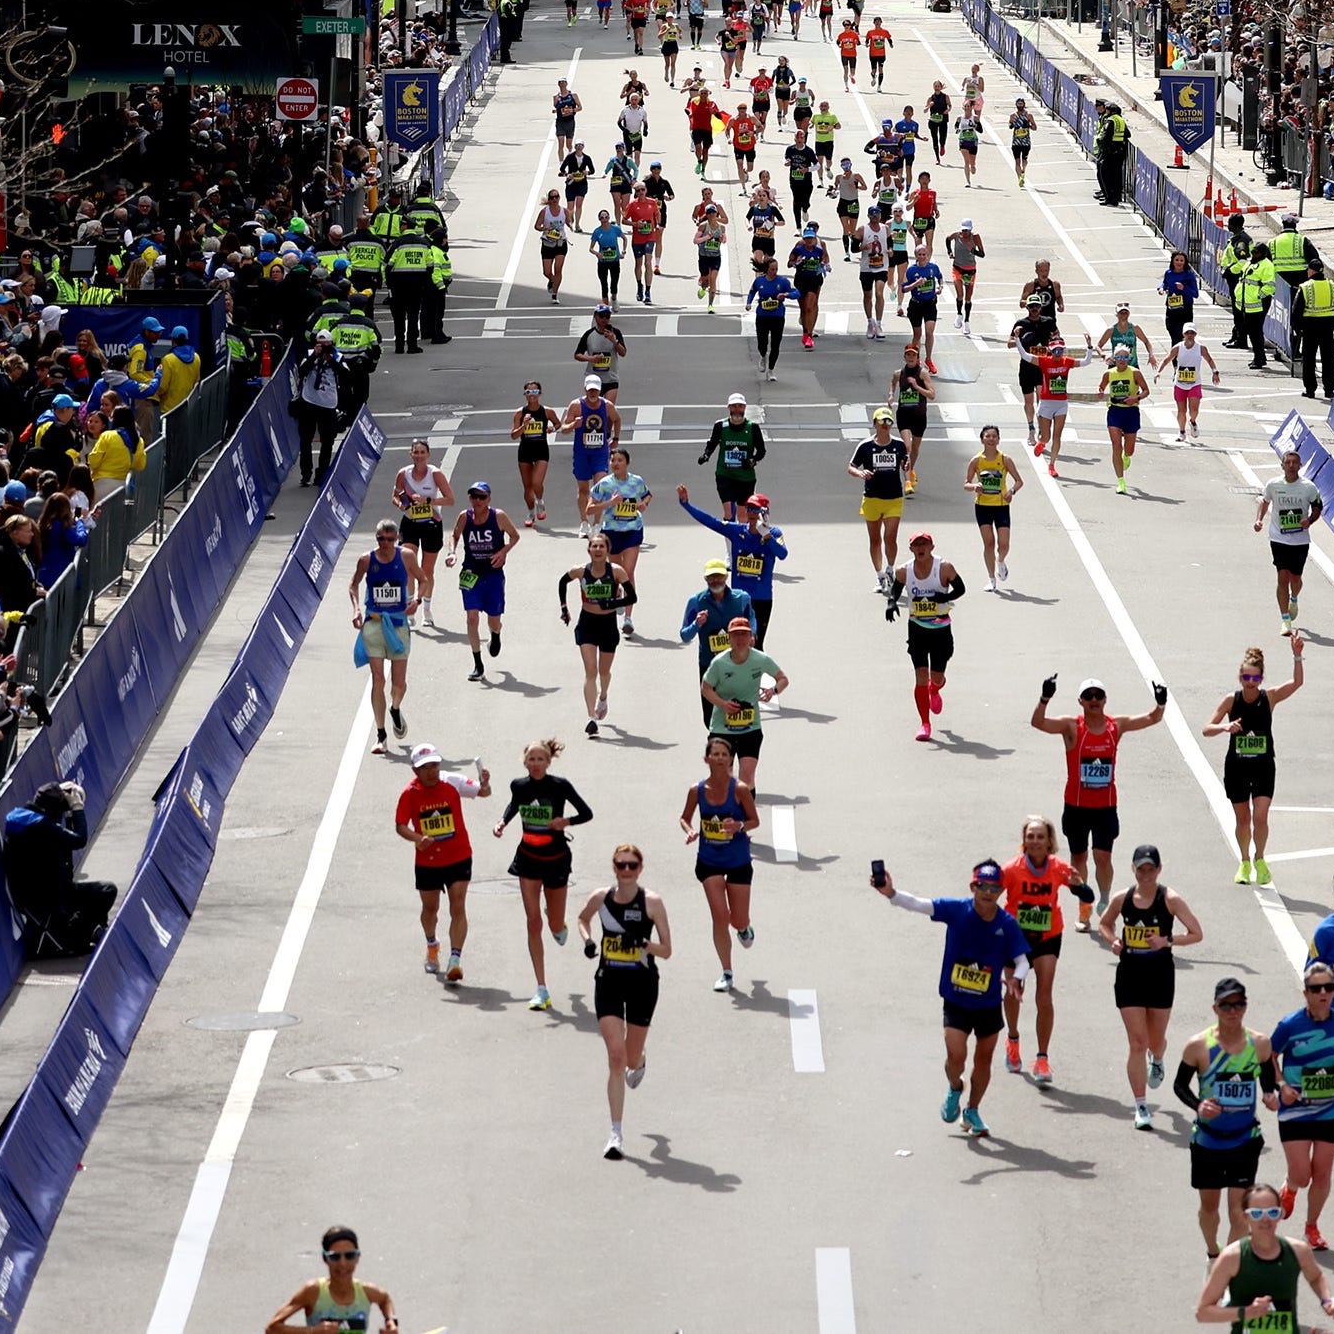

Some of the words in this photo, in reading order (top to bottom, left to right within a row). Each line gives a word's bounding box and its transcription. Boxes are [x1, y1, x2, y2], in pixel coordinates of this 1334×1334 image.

[316, 21, 349, 33] EXETER
[163, 50, 210, 63] HOTEL
[283, 86, 293, 94] DO
[297, 86, 312, 94] NOT
[285, 104, 309, 112] ENTER
[397, 107, 427, 115] BOSTON
[1174, 109, 1203, 117] BOSTON
[355, 253, 375, 261] POLICE
[406, 257, 422, 265] POLICE
[339, 330, 362, 339] Boston
[339, 337, 361, 346] Police
[875, 455, 895, 463] 10055
[1278, 497, 1303, 505] ITALIA
[468, 529, 493, 543] ALS
[375, 588, 398, 598] 11501
[420, 801, 449, 812] CHINA
[423, 817, 451, 831] 19811
[1022, 881, 1052, 896] LDN
[1218, 1082, 1252, 1098] 15075
